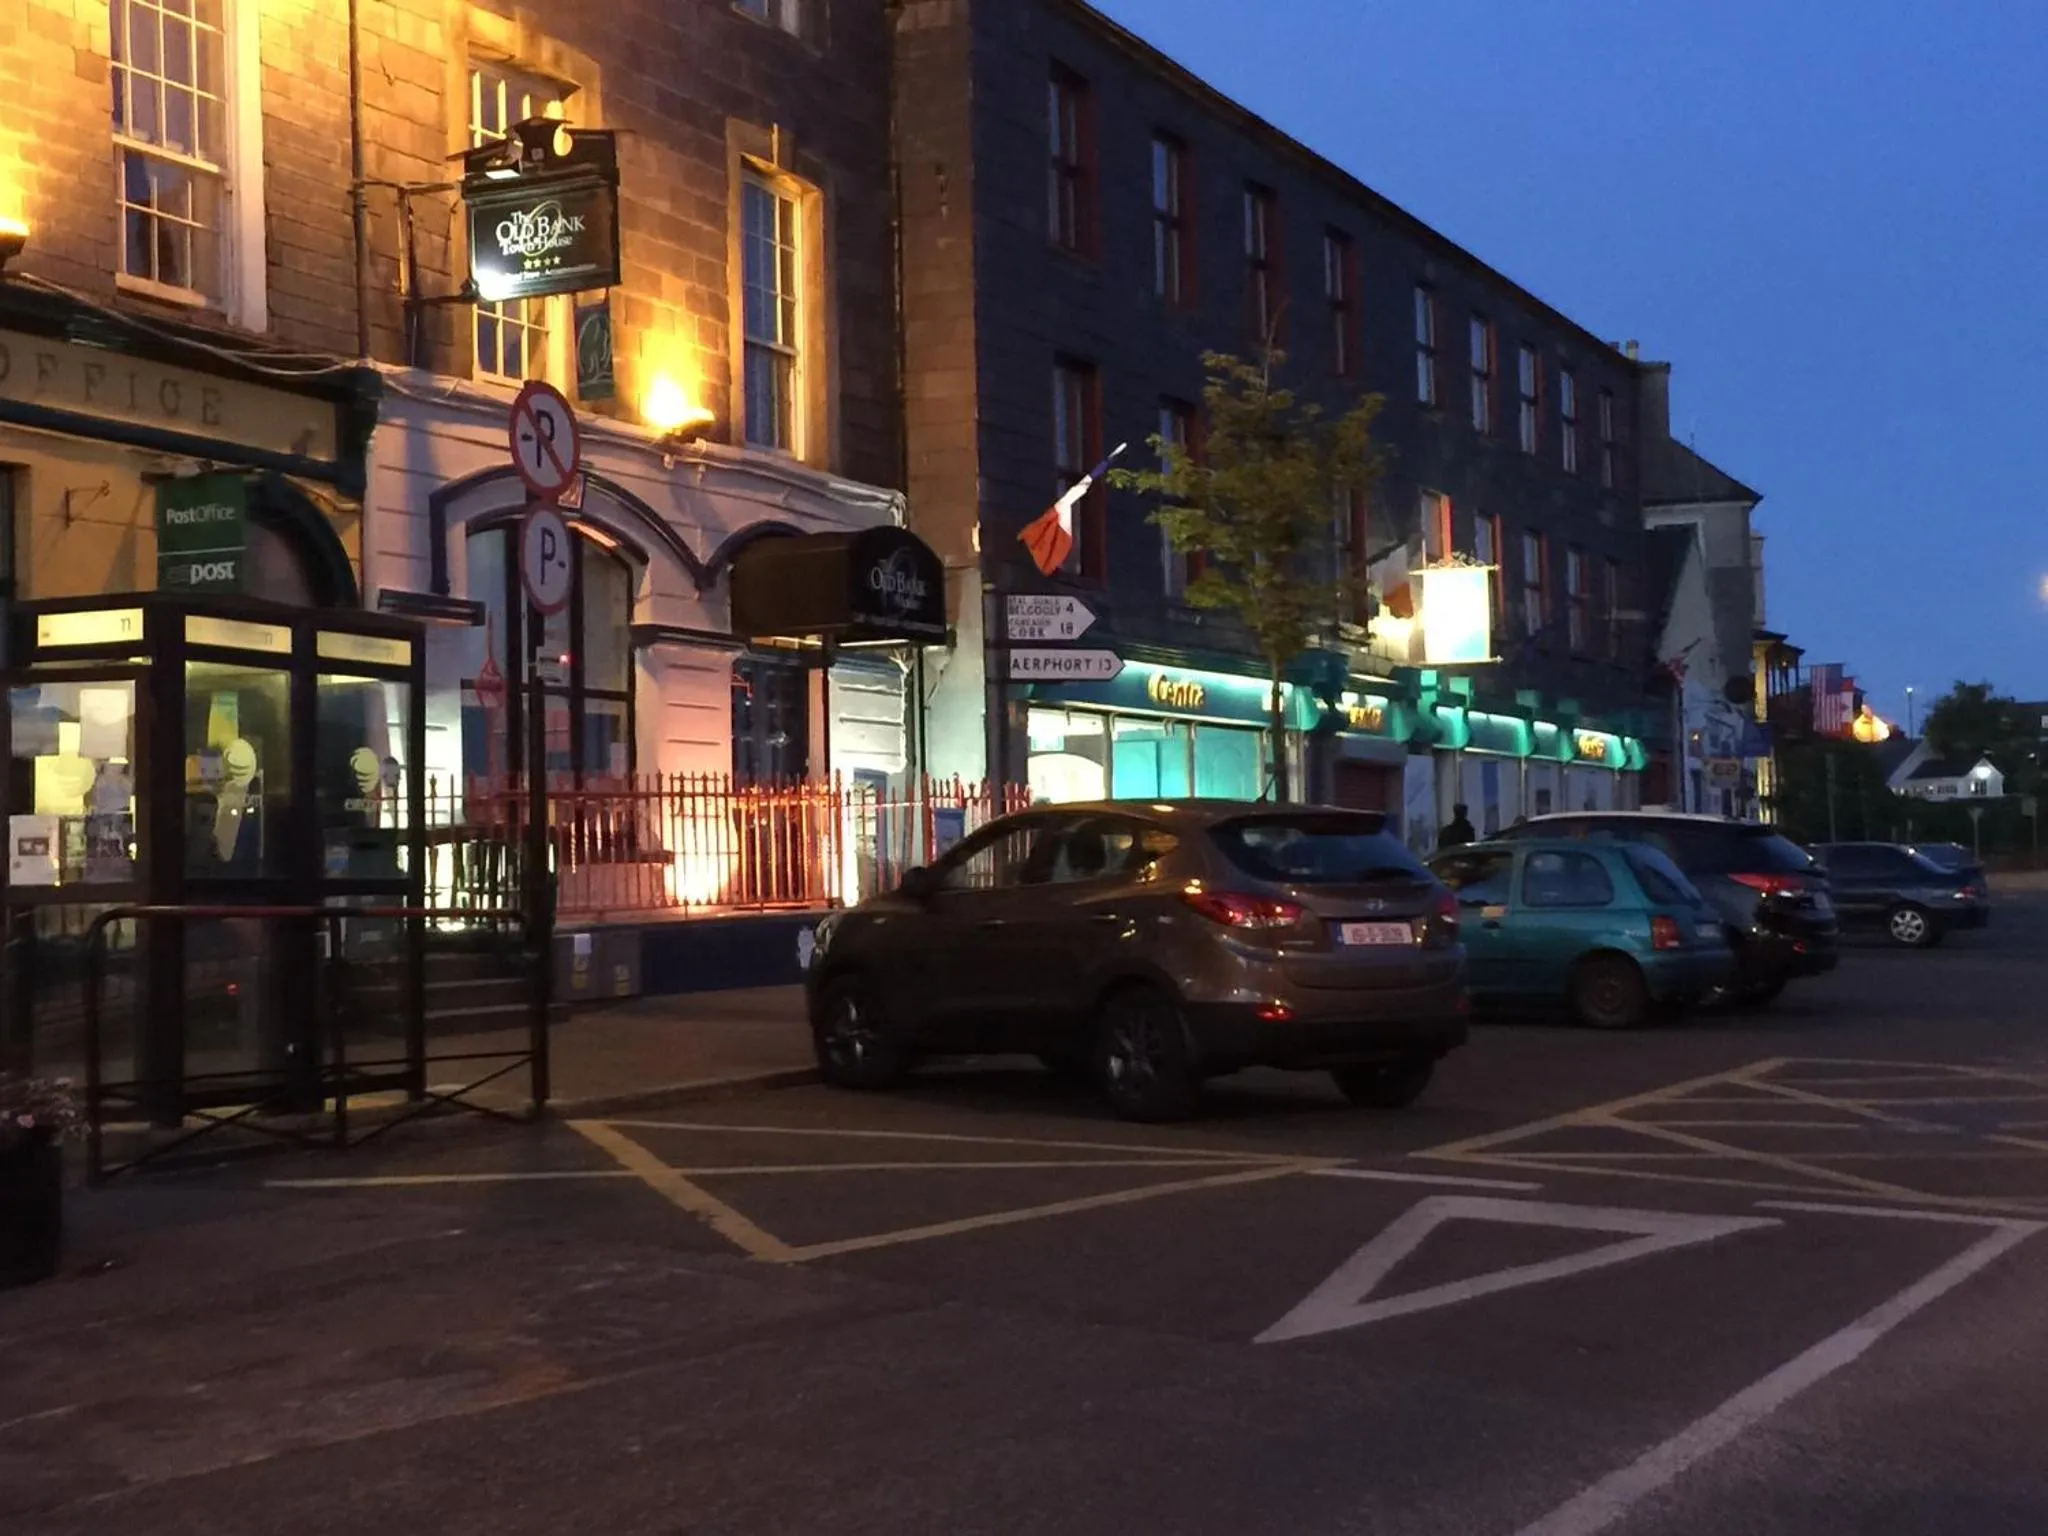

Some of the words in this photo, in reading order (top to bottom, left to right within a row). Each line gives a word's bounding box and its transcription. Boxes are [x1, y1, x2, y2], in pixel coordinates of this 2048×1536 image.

[190, 561, 235, 585] post
[1066, 602, 1075, 614] 4
[1012, 658, 1093, 672] AERPHORT
